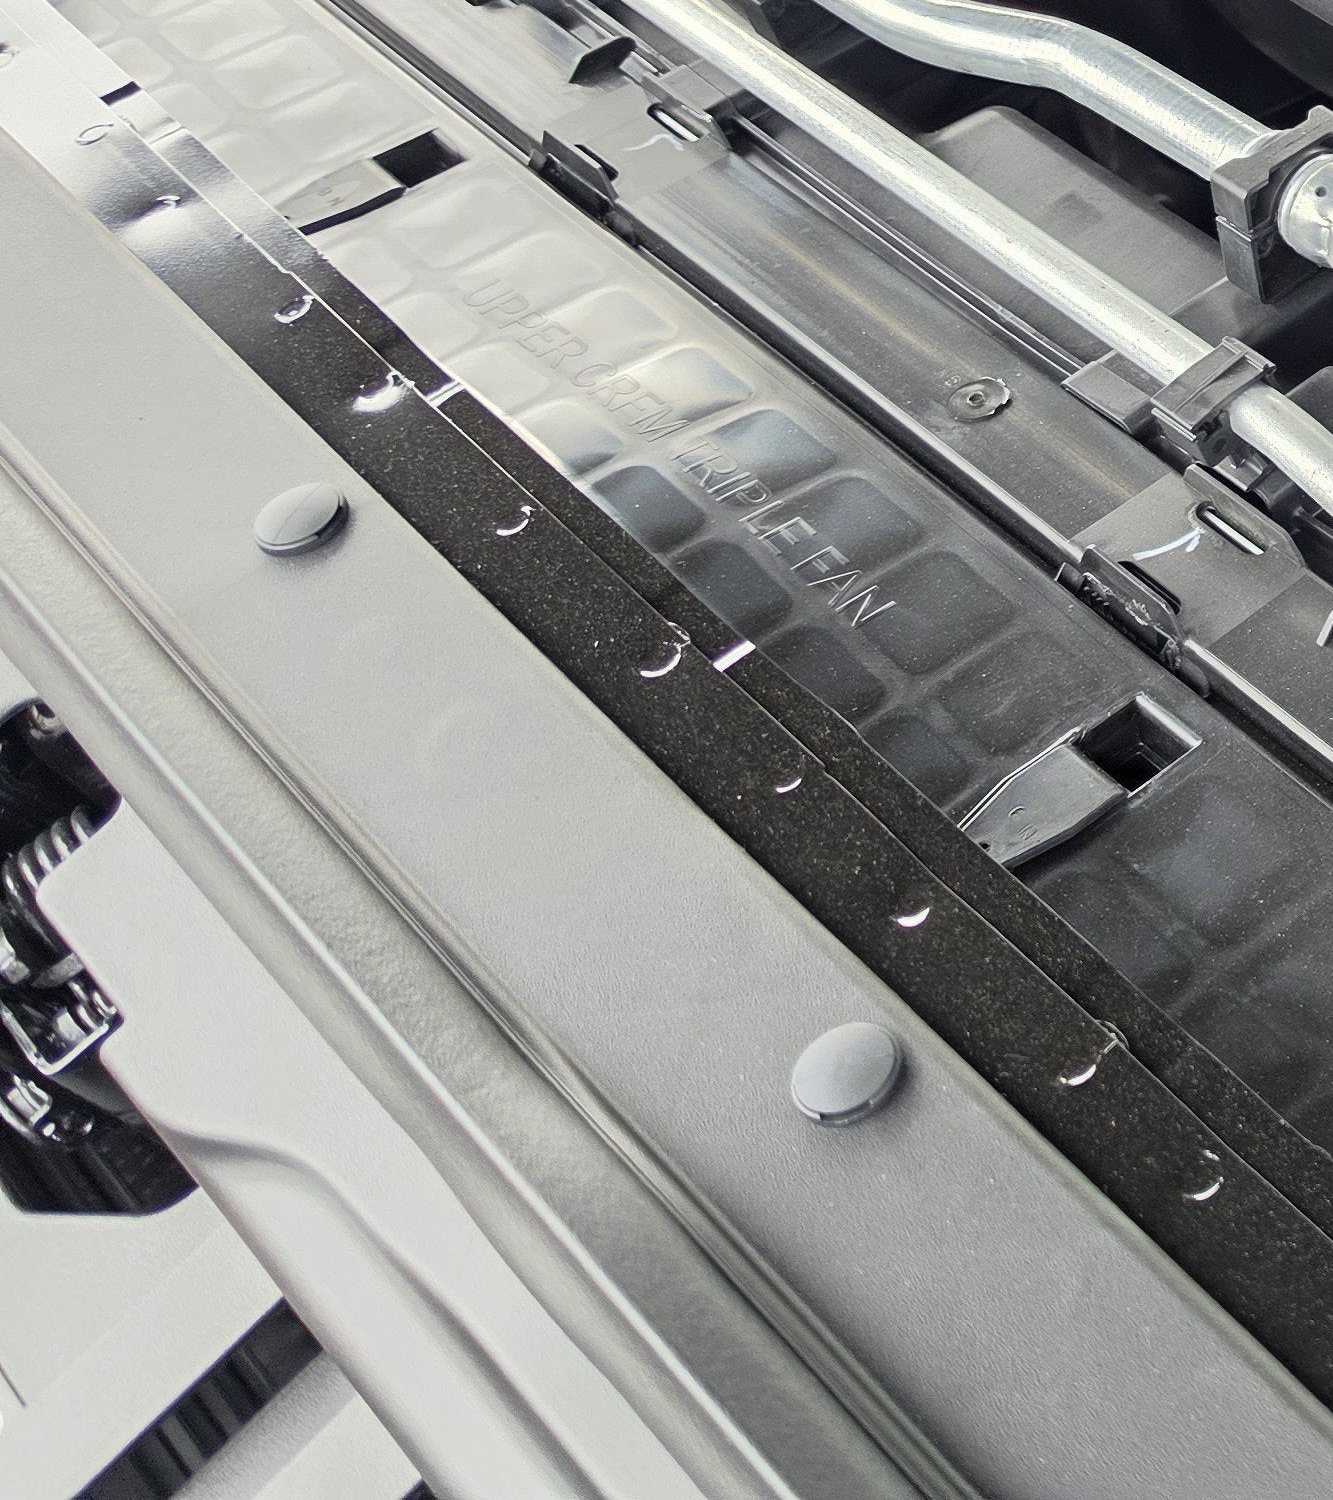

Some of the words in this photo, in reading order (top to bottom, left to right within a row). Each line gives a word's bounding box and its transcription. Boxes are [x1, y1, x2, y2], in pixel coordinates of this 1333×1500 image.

[462, 277, 588, 370] UPPER
[572, 361, 691, 443] CRFM
[671, 436, 817, 558] TRIPLE
[790, 545, 897, 628] FAN
